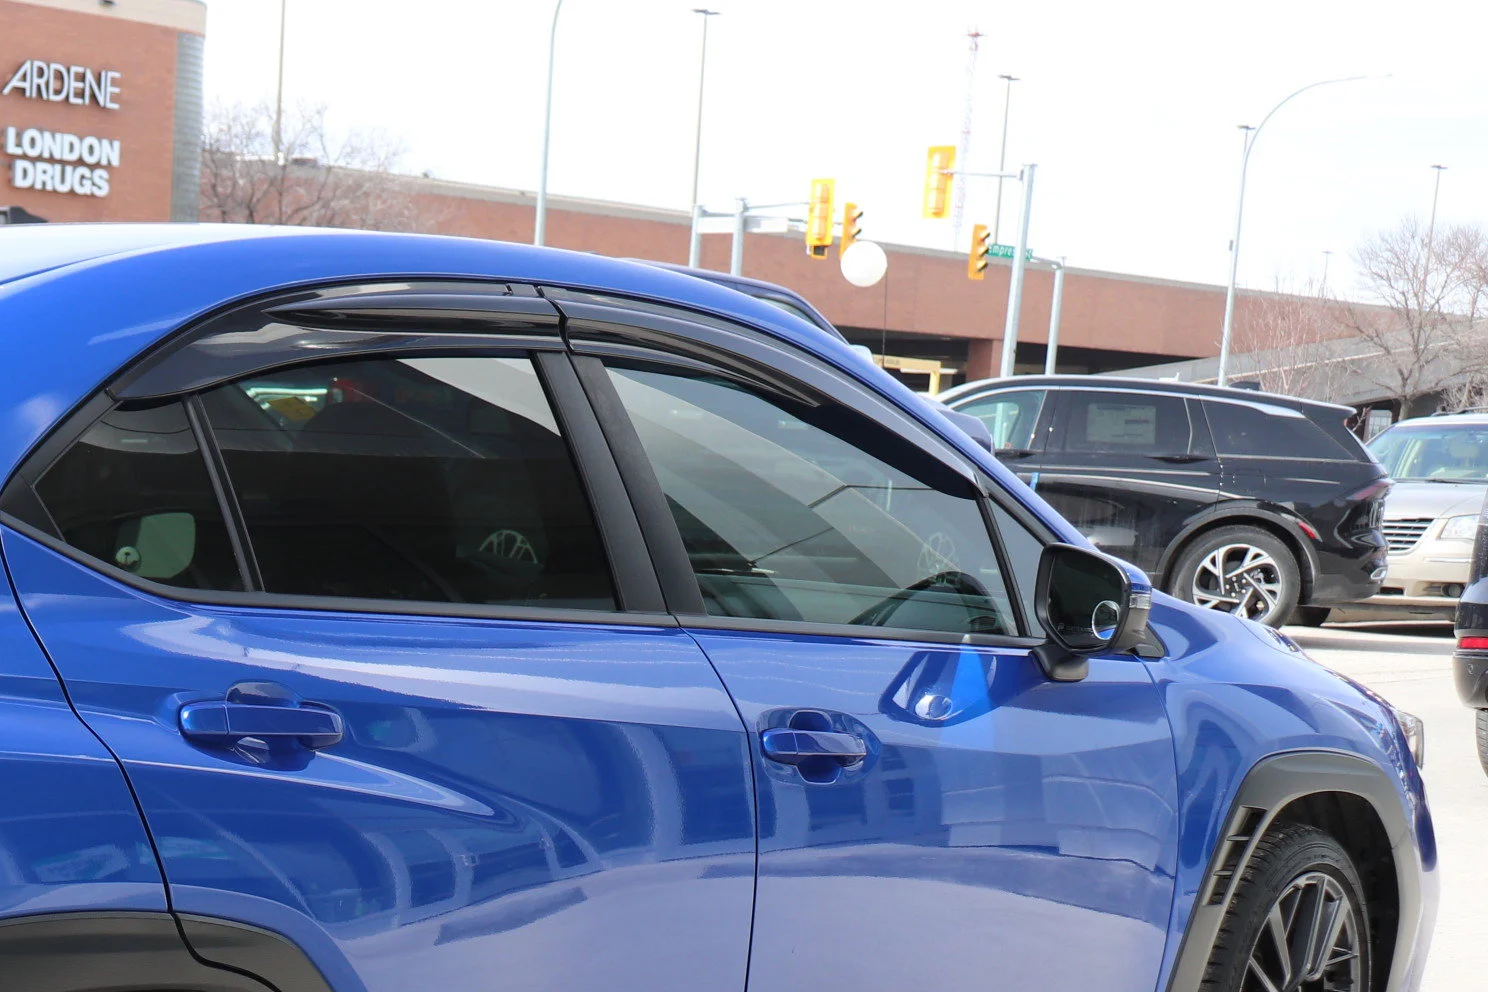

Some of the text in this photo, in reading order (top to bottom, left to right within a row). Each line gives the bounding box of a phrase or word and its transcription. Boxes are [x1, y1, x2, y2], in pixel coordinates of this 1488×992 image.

[2, 60, 121, 109] ARDENE
[6, 126, 120, 167] LONDON
[13, 159, 110, 197] DRUGS
